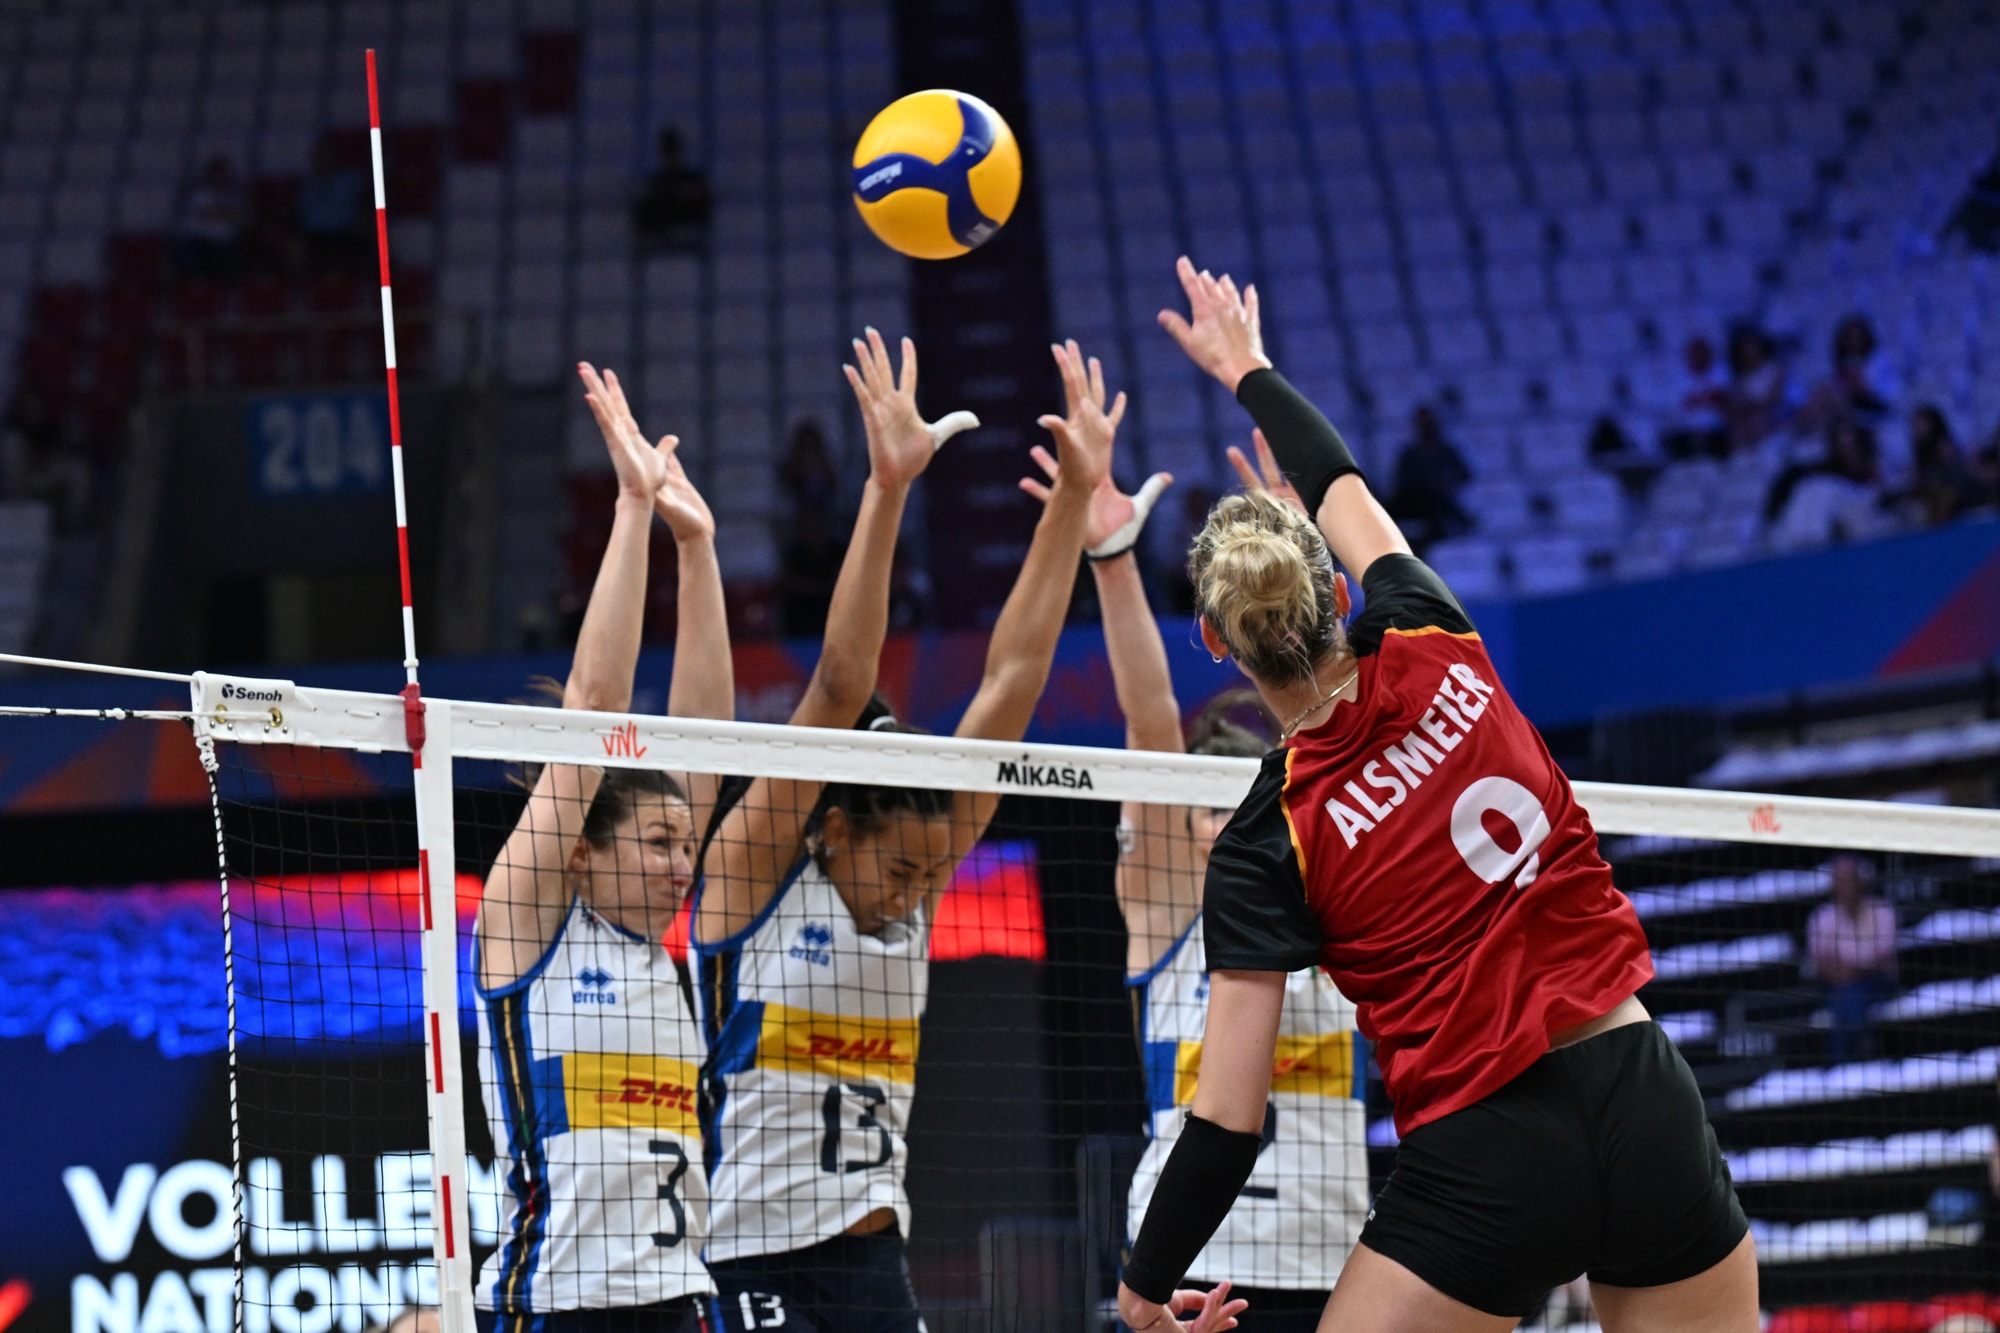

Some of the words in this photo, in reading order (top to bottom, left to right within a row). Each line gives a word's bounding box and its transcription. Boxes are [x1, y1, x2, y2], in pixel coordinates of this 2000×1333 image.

[261, 404, 383, 489] 204
[235, 687, 283, 702] Senoh
[1325, 663, 1494, 850] ALSMEIER
[1451, 776, 1551, 890] 9
[808, 1034, 901, 1062] DHL
[619, 1078, 695, 1113] DHL
[821, 1085, 892, 1173] 13
[649, 1140, 688, 1248] 3
[738, 1291, 786, 1331] 13
